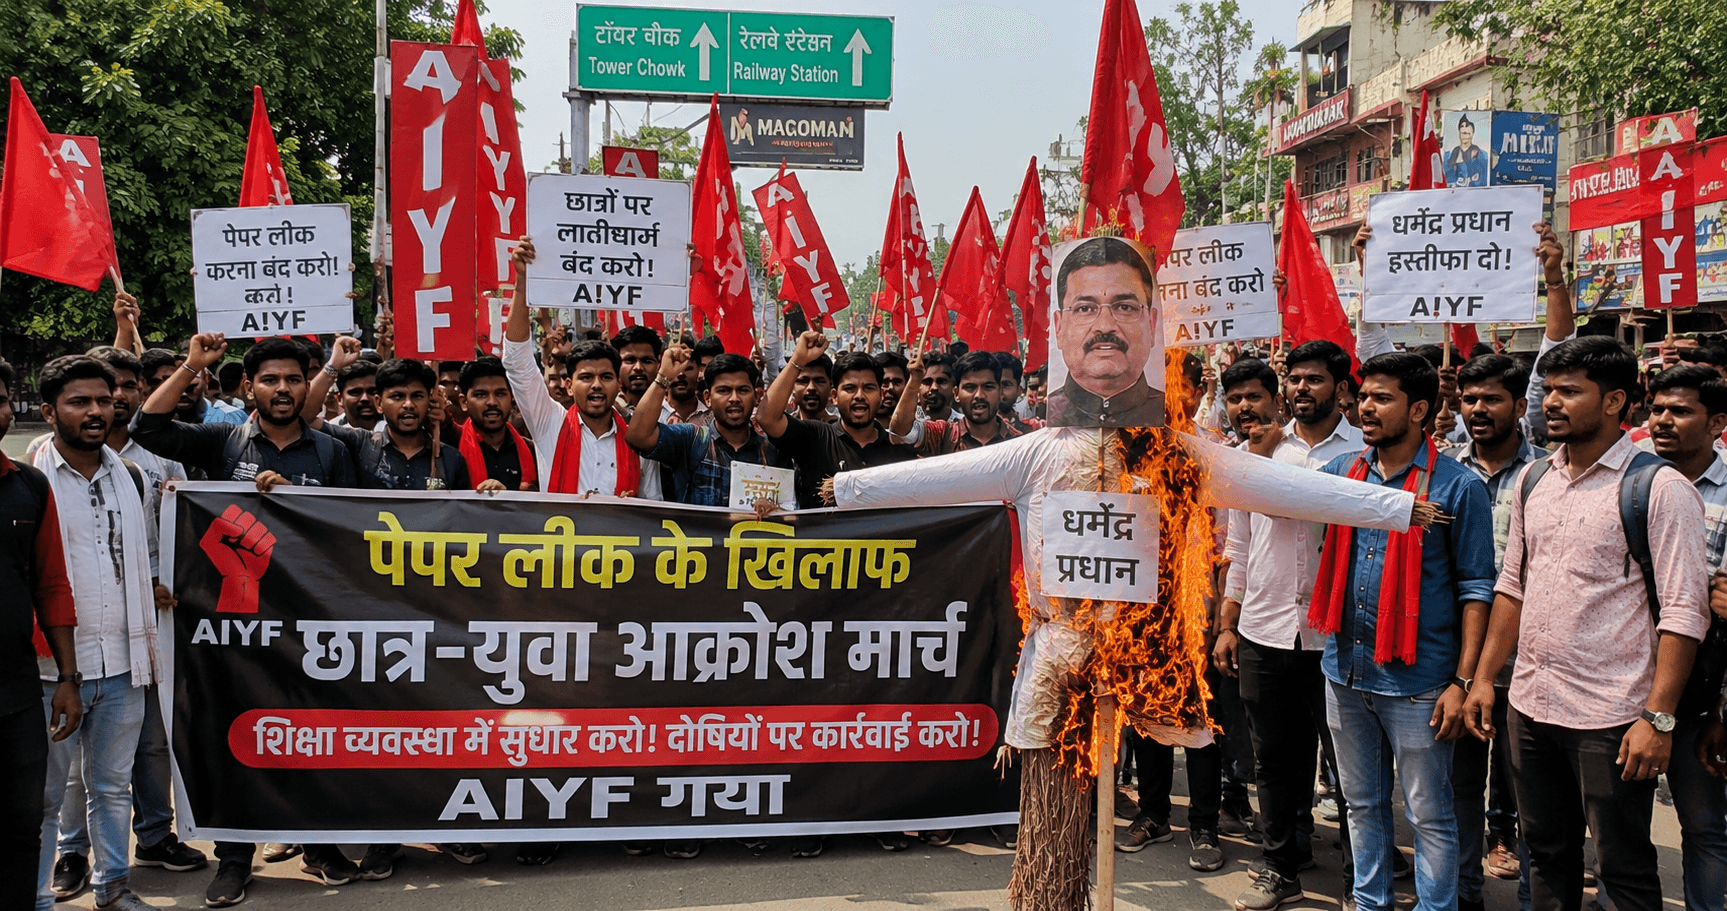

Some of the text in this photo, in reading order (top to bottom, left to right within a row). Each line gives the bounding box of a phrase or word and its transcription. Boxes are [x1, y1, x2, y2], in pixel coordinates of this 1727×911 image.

[738, 25, 780, 50] रेलवे
[588, 56, 686, 78] Tower Chowk
[733, 61, 838, 85] Railway Station
[403, 50, 462, 353] AIYF
[623, 195, 653, 215] पर
[222, 220, 316, 247] पेपर लीक
[1450, 210, 1513, 233] प्रधान
[560, 250, 595, 275] बंद
[1197, 239, 1244, 265] लीक
[1387, 243, 1472, 274] इस्तीफा
[205, 261, 257, 281] करना
[261, 256, 291, 278] बंद
[1226, 267, 1264, 294] करो
[363, 511, 917, 591] पेपर लीक के खिलाफ
[1056, 555, 1140, 586] प्रधान
[191, 618, 283, 646] AIYF
[615, 602, 833, 683] आक्रोश
[843, 601, 968, 679] मार्च
[252, 716, 337, 758] शिक्षा
[463, 717, 495, 756] में
[498, 725, 582, 767] सुधार
[587, 715, 657, 753] करो!
[665, 713, 764, 753] दोषियों
[766, 722, 806, 751] पर
[810, 712, 912, 752] कार्रवाई
[917, 711, 980, 748] करो!
[438, 774, 791, 822] AIYF गया
